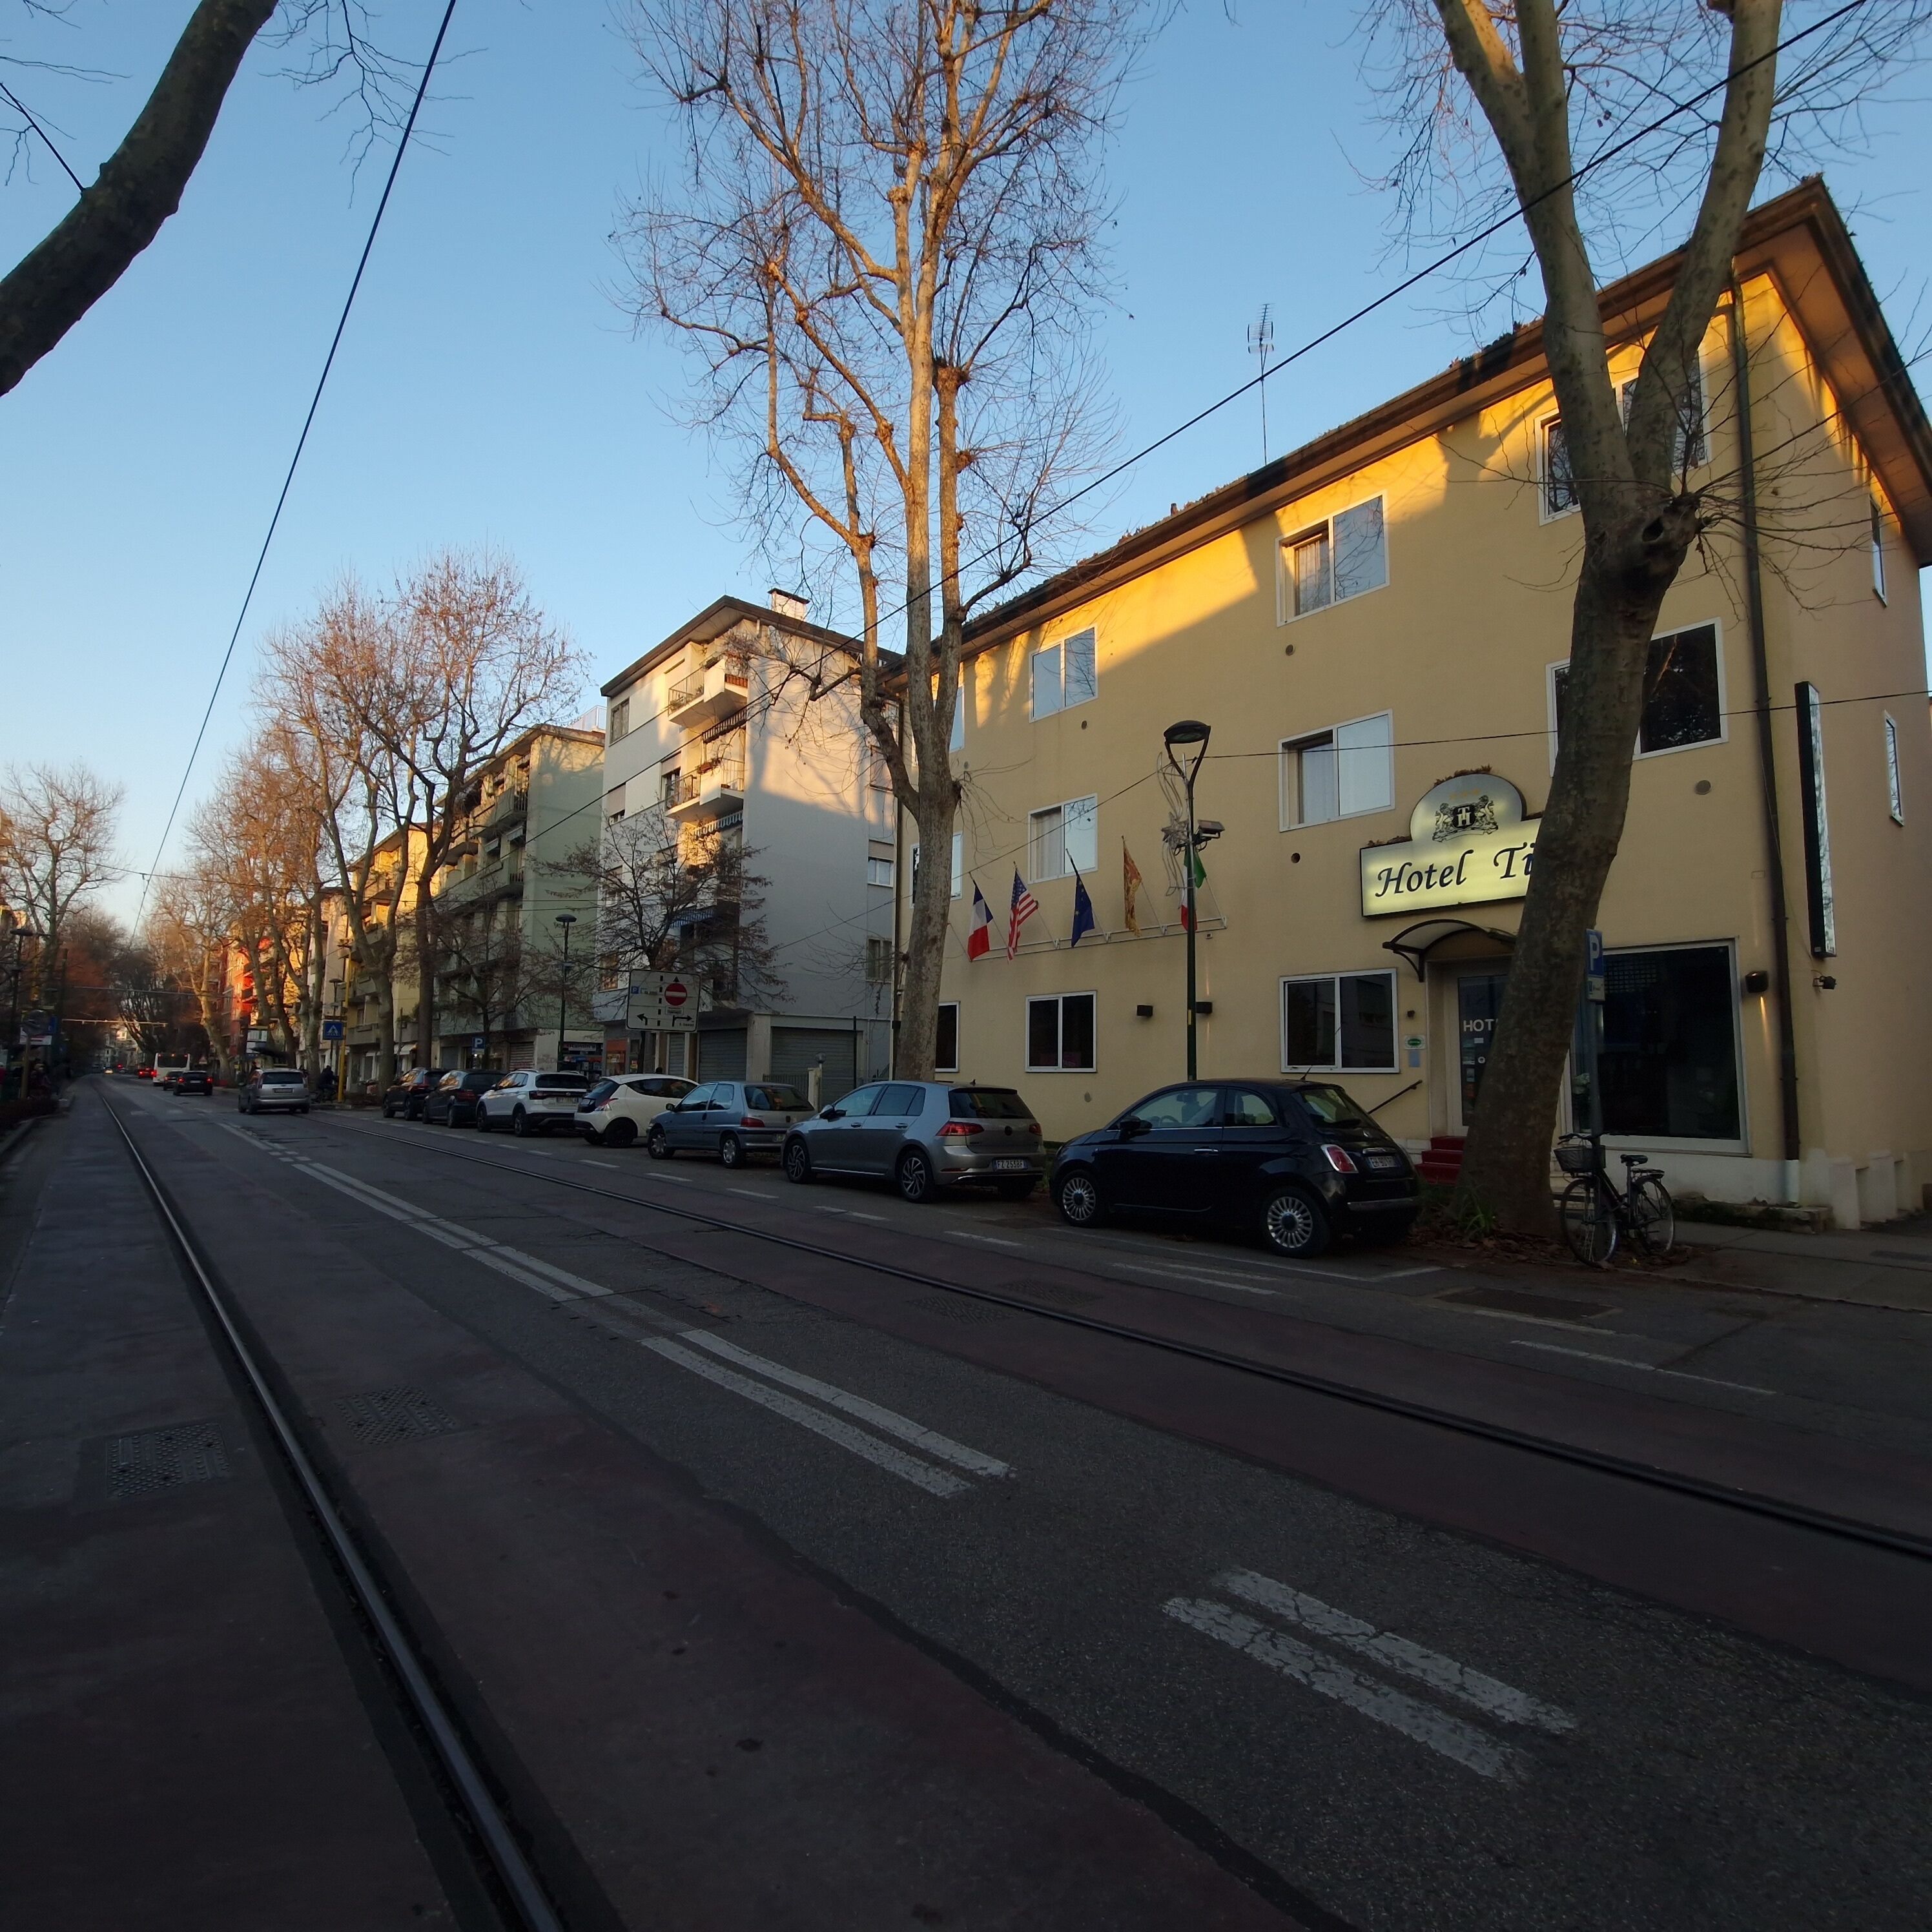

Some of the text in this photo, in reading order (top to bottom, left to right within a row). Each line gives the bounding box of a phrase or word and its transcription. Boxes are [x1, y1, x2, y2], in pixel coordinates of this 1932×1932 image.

[1375, 841, 1535, 898] Hotel Ti
[1589, 934, 1599, 971] P
[1463, 1018, 1499, 1032] HOT
[475, 1038, 483, 1047] P
